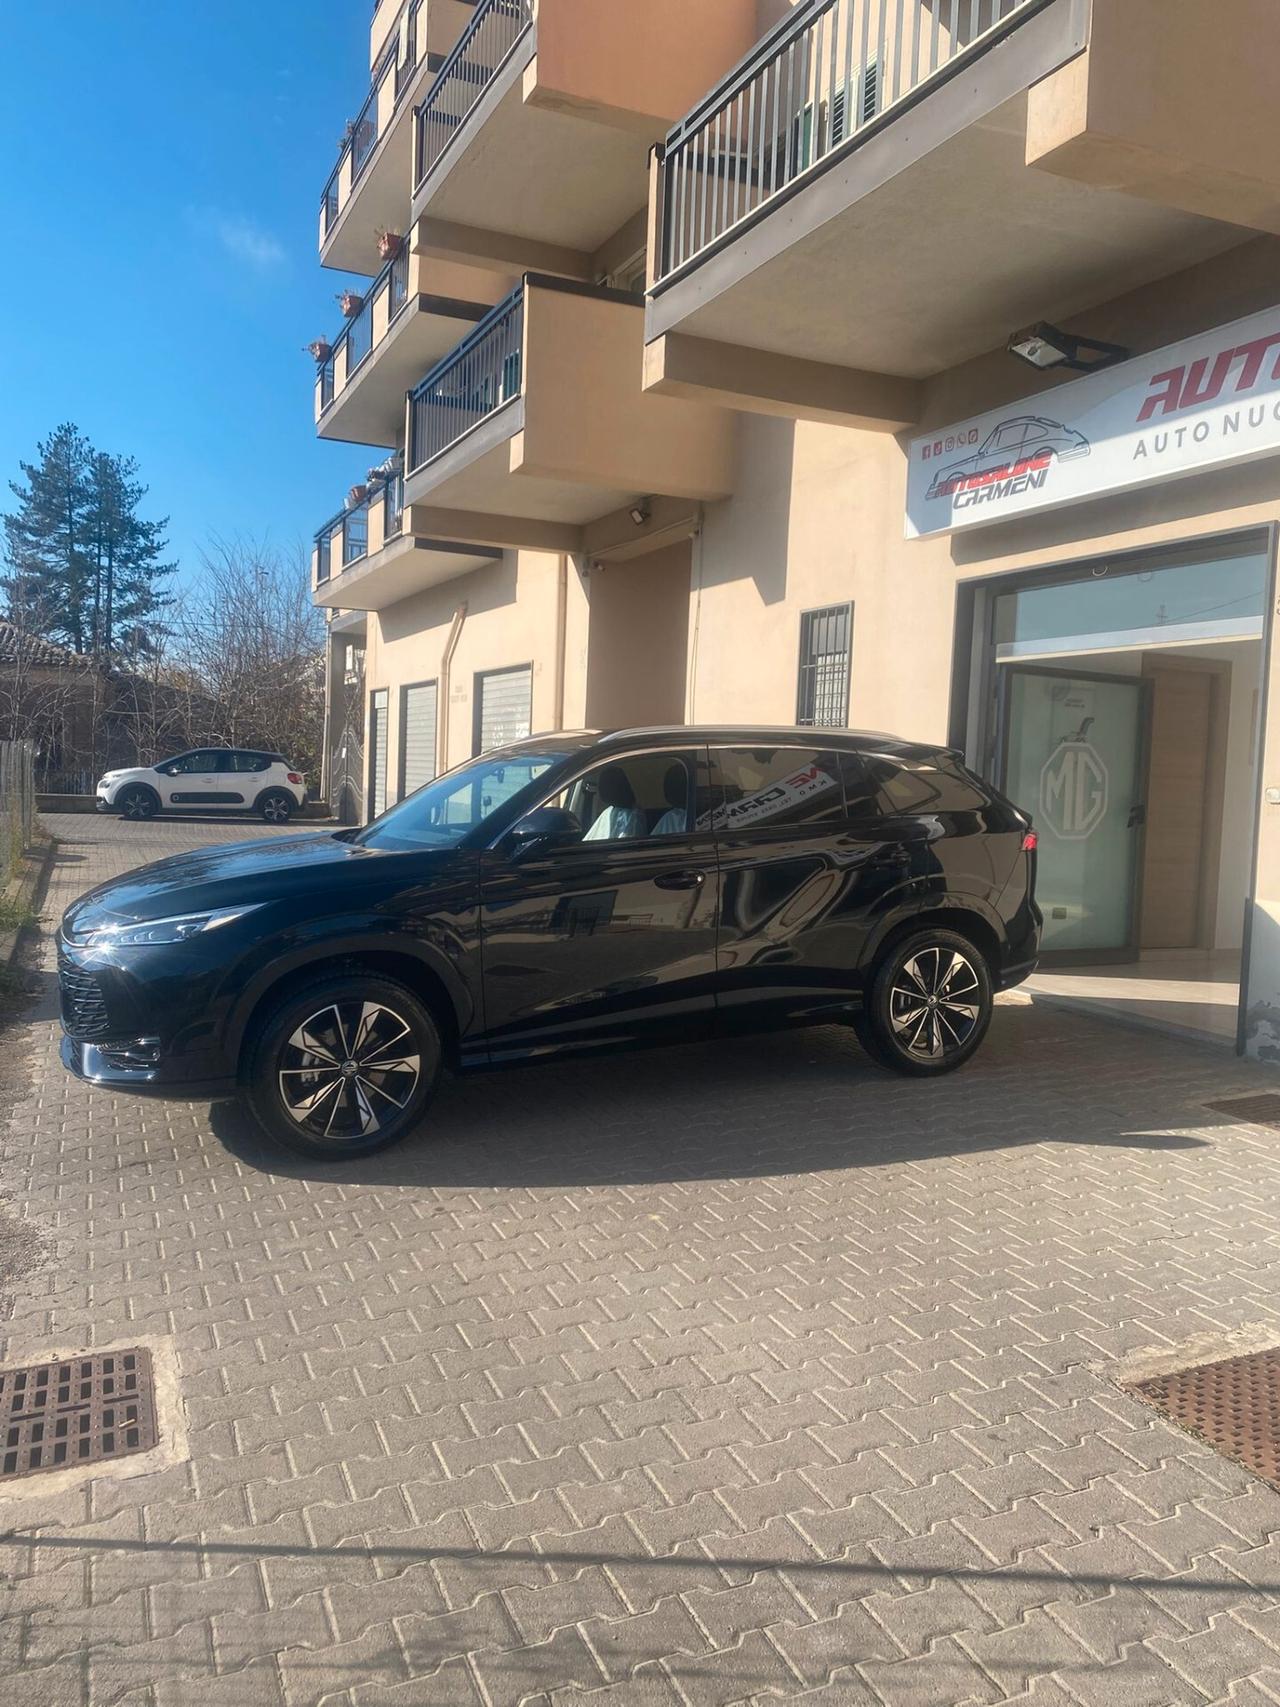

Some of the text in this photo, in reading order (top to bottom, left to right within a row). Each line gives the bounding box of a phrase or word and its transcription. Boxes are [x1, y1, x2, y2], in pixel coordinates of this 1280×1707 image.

[1136, 332, 1280, 422] AUT
[1133, 421, 1210, 460] AUTO
[953, 469, 1049, 509] CARMENI
[1046, 751, 1101, 831] MG
